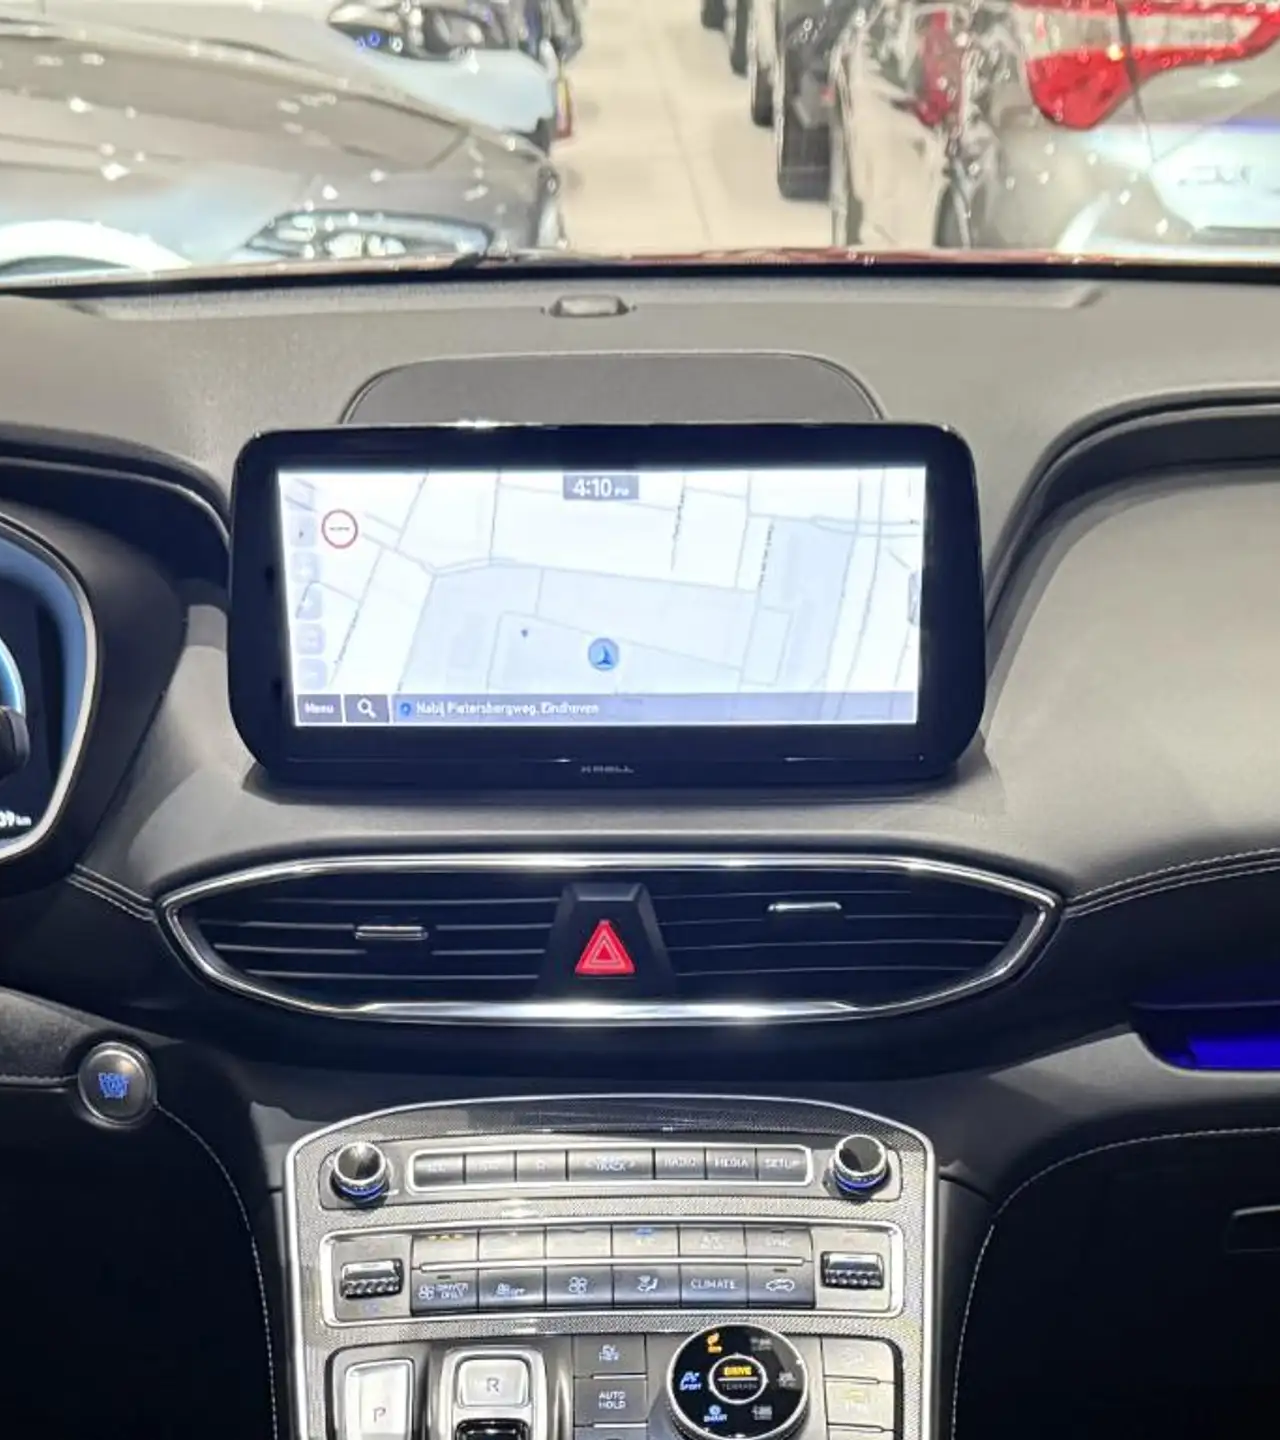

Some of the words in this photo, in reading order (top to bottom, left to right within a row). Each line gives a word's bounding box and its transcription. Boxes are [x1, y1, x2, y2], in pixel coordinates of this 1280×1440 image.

[572, 478, 613, 497] 4:10
[303, 701, 335, 714] Menu
[541, 702, 600, 715] Eindhoven
[714, 1155, 749, 1169] MEDIA
[690, 1278, 737, 1291] CLIMATE
[485, 1377, 500, 1393] R
[598, 1391, 626, 1400] AUTO
[598, 1400, 627, 1410] HOLD
[372, 1406, 387, 1423] P
